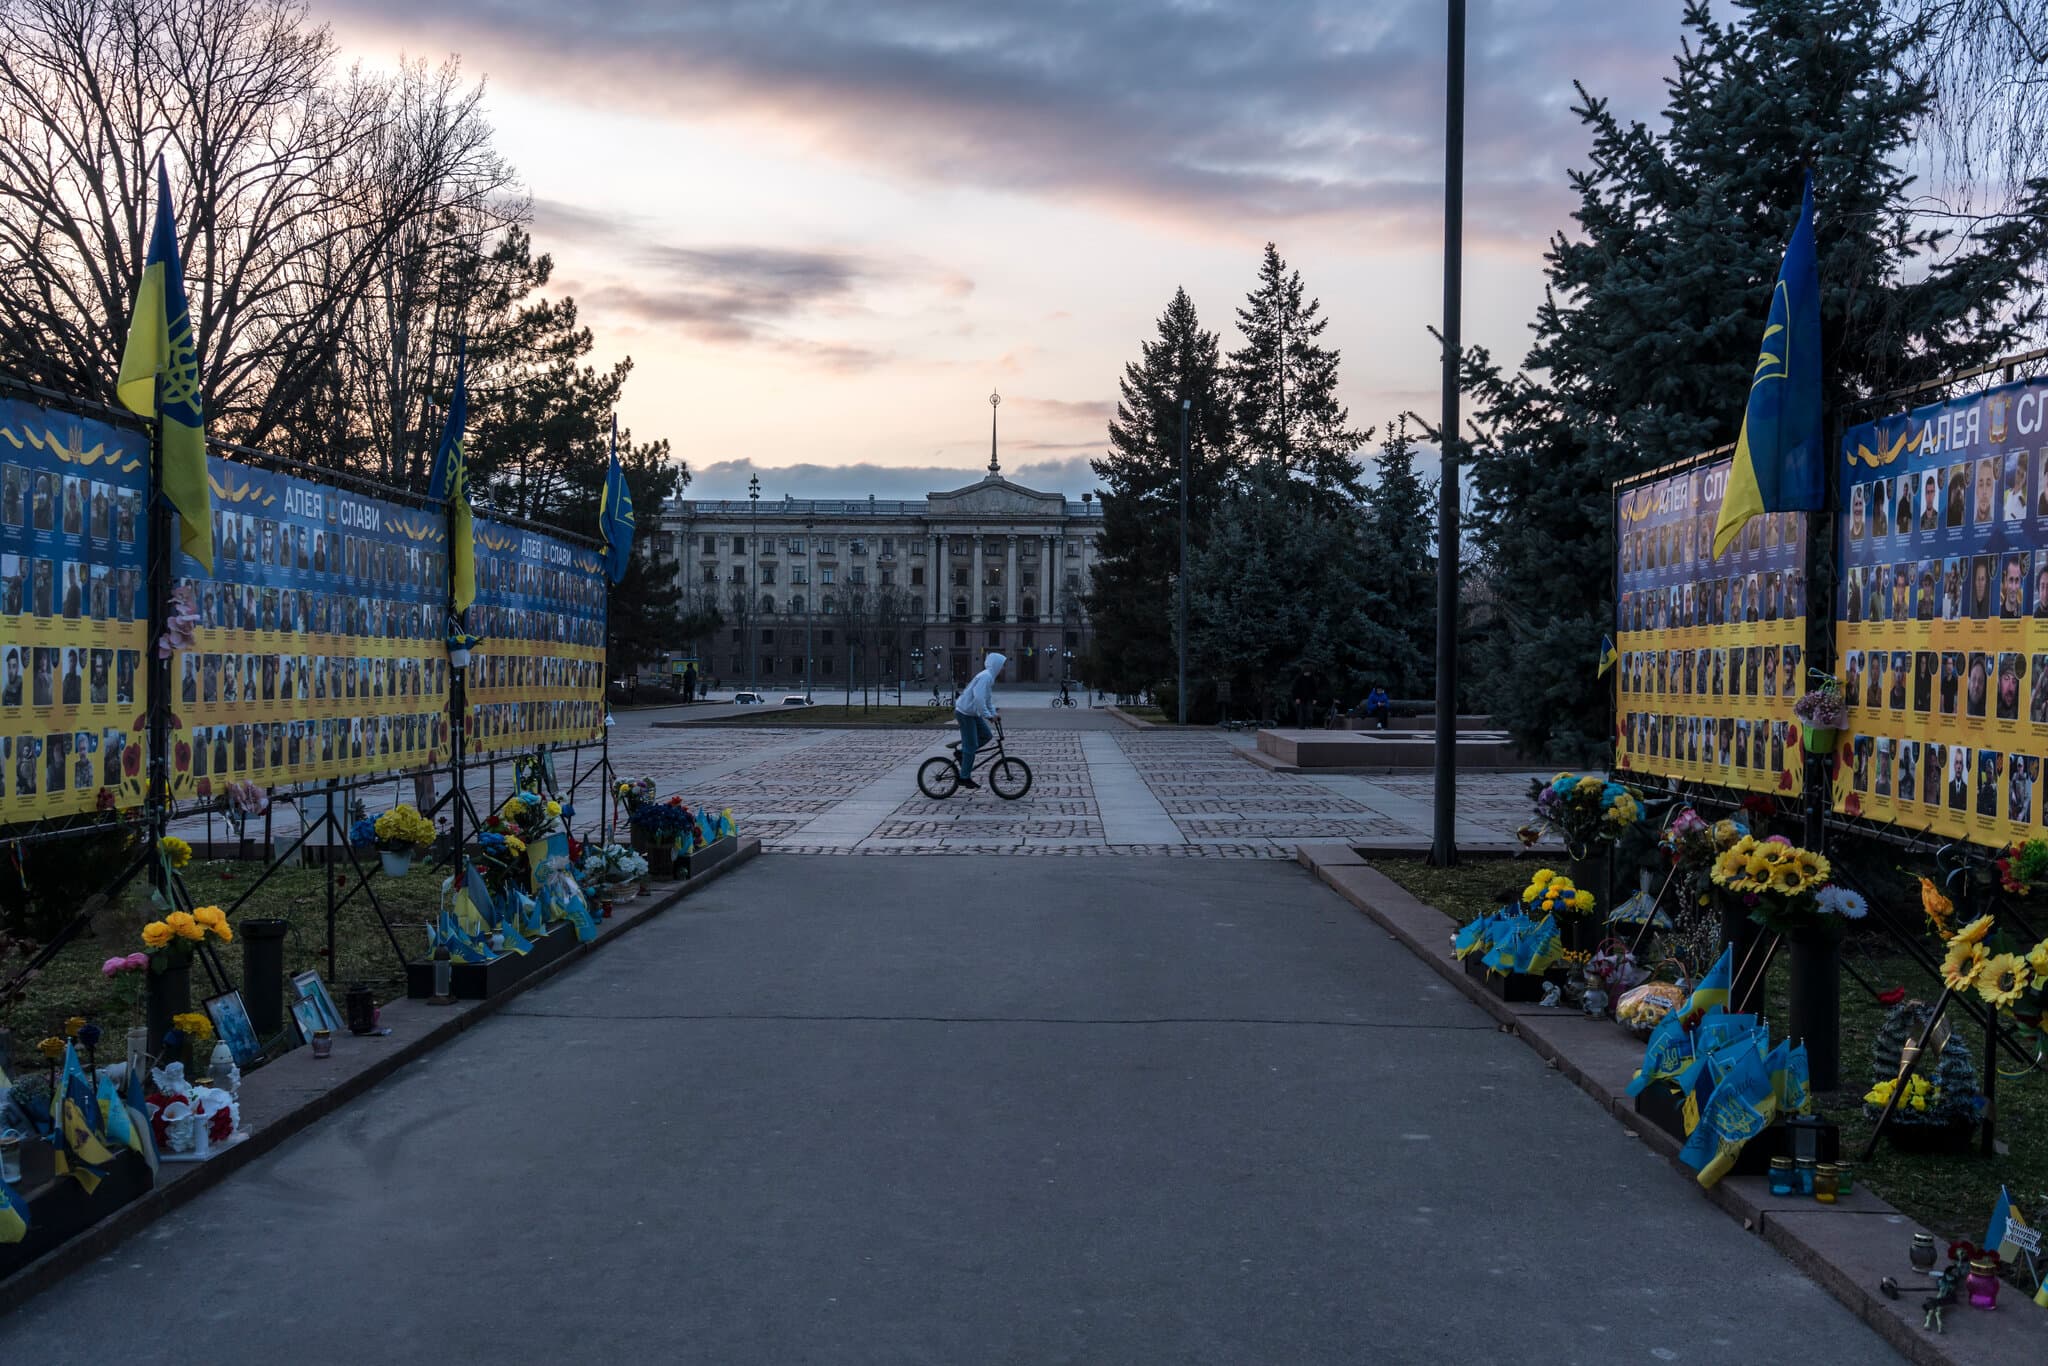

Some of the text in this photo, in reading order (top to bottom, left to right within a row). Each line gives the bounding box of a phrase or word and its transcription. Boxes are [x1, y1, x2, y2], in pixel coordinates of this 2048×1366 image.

[1918, 406, 1981, 457] АЛЕЯ
[284, 486, 380, 533] АЛЕЯ СЛАВИ
[1657, 481, 1688, 516] АЛЕЯ
[520, 536, 572, 568] АЛЕЯ СЛАВИ
